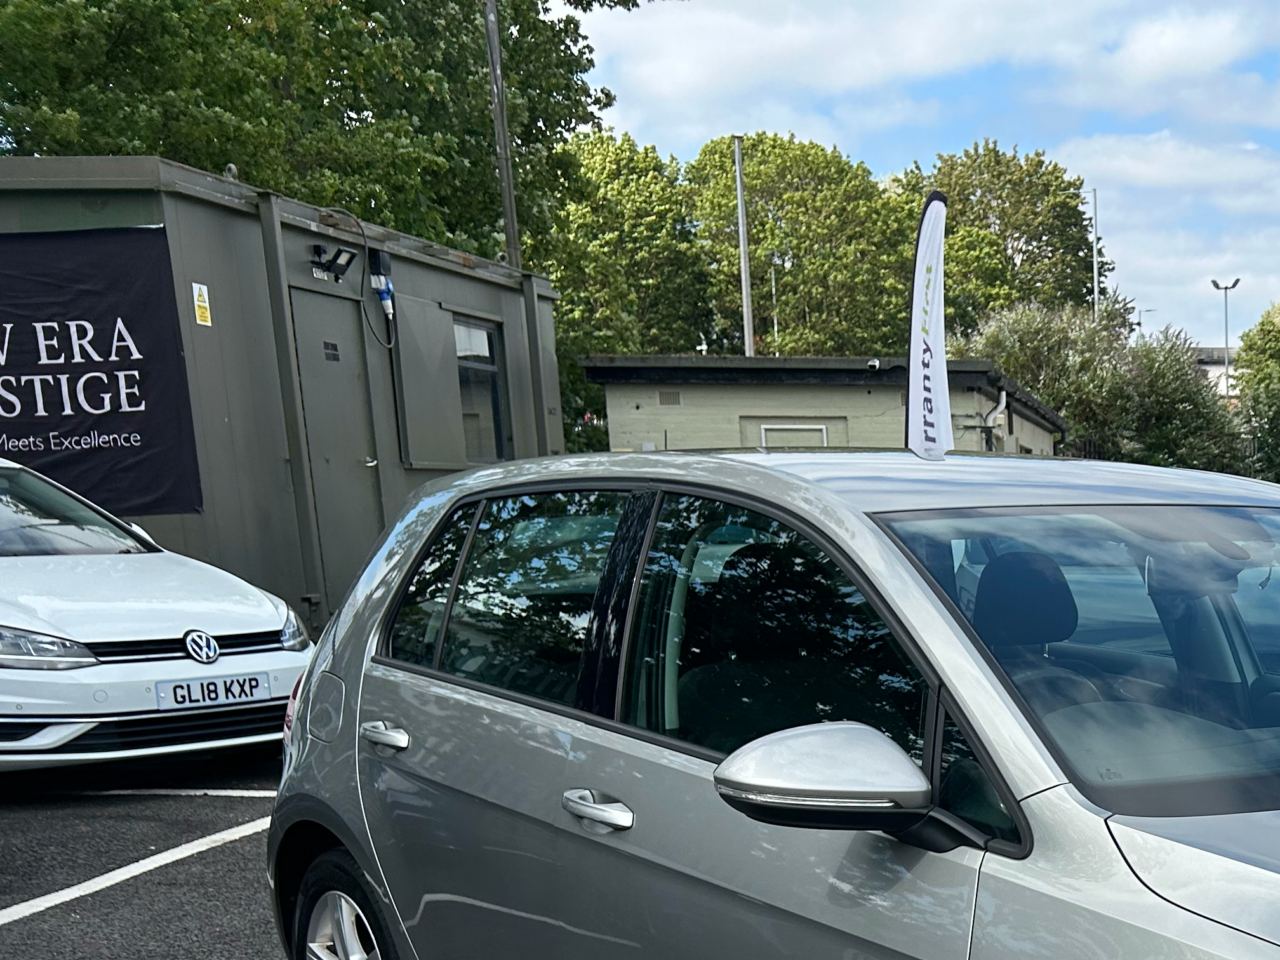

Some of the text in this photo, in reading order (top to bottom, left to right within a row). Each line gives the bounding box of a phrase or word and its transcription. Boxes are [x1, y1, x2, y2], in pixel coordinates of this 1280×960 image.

[32, 317, 143, 364] ERA
[49, 430, 141, 450] Excellence
[172, 677, 259, 704] GL18 KXP
